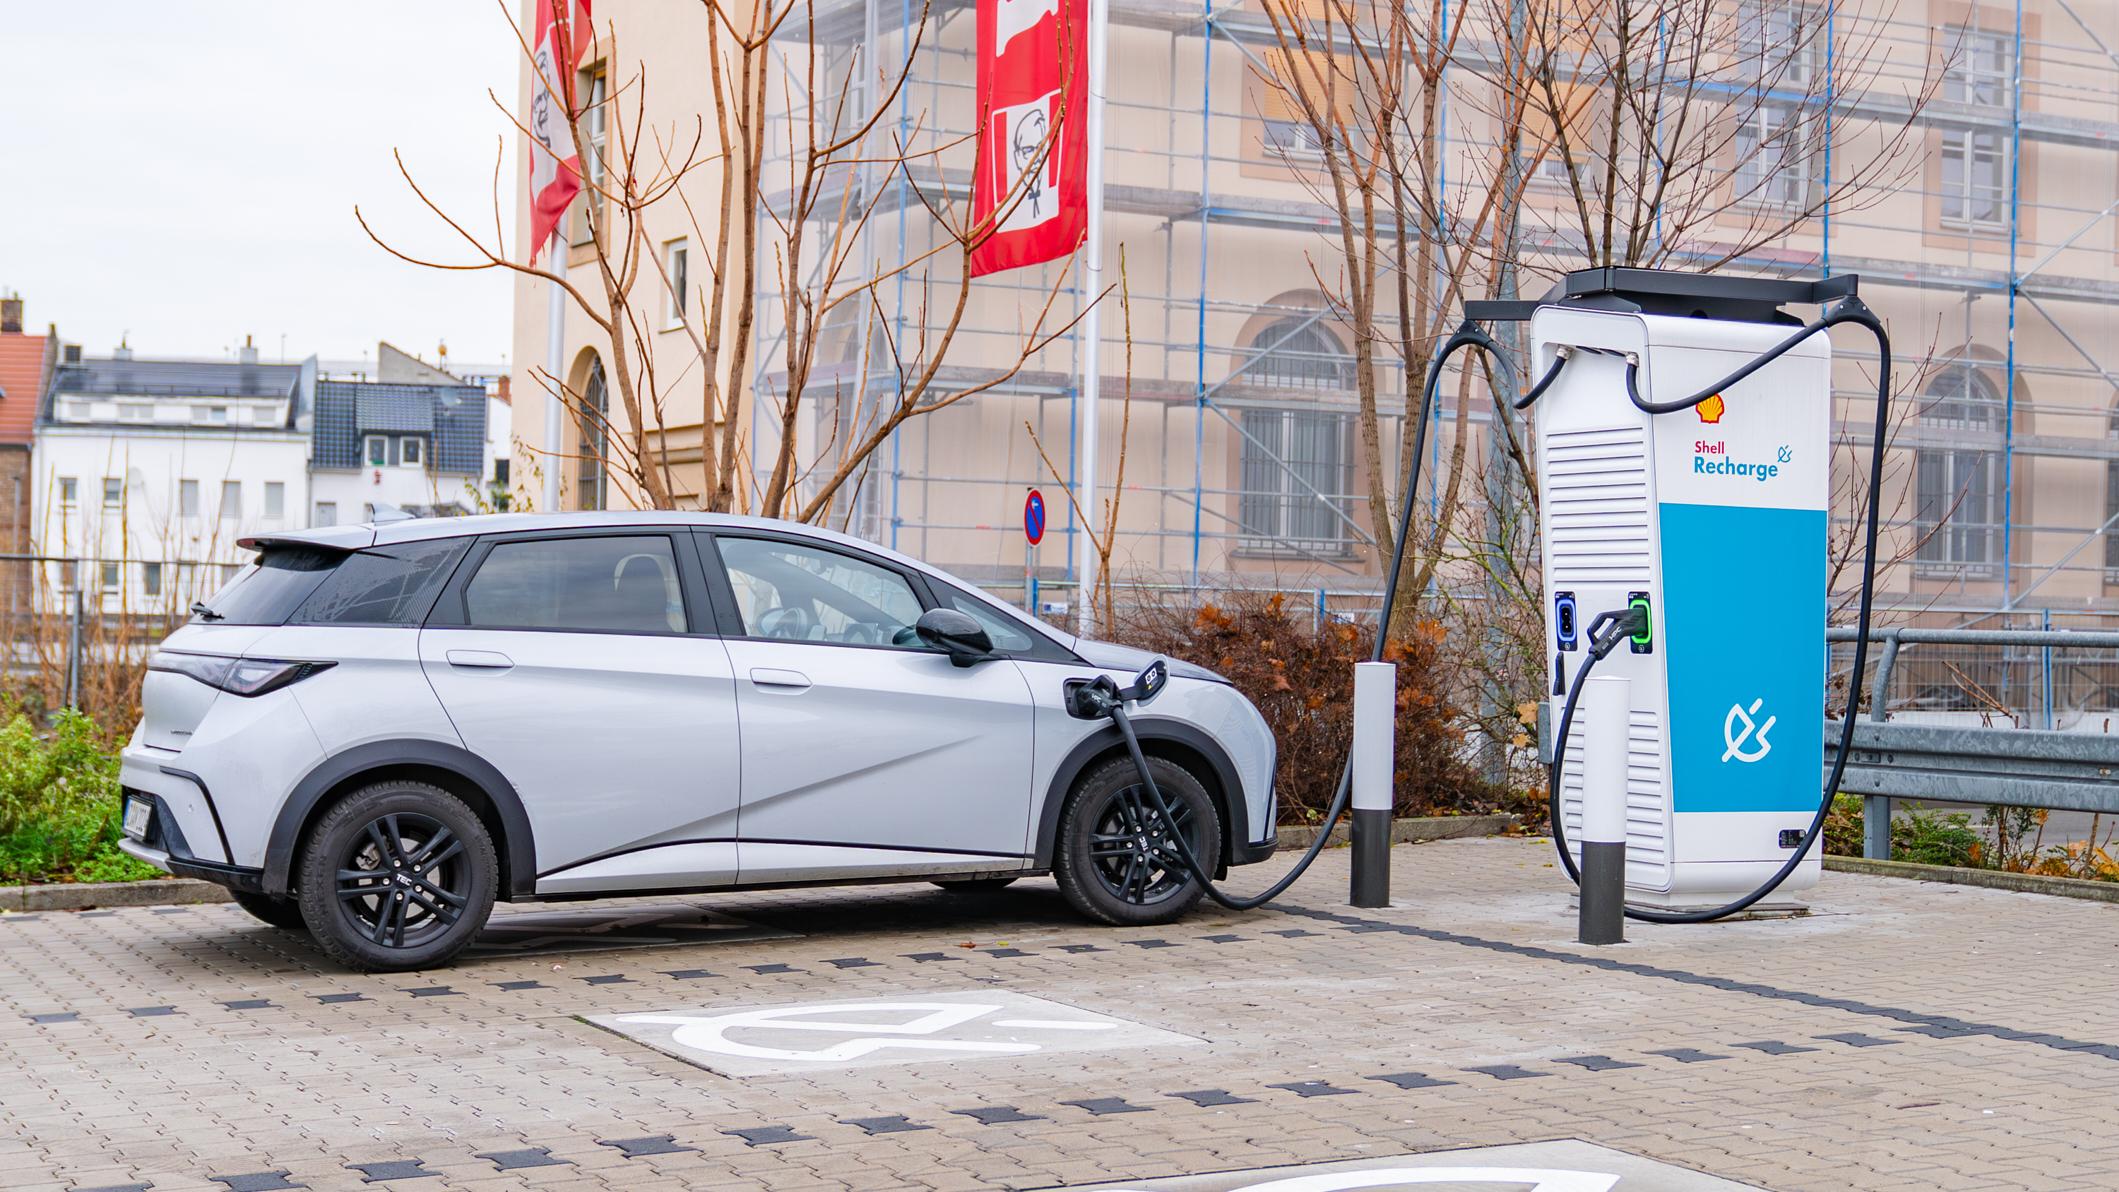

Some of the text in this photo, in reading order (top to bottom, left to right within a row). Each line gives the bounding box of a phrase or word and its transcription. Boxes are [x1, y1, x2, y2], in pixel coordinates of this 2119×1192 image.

[1694, 440, 1725, 454] Shell
[1694, 456, 1778, 481] Recharge
[396, 873, 413, 886] TEC
